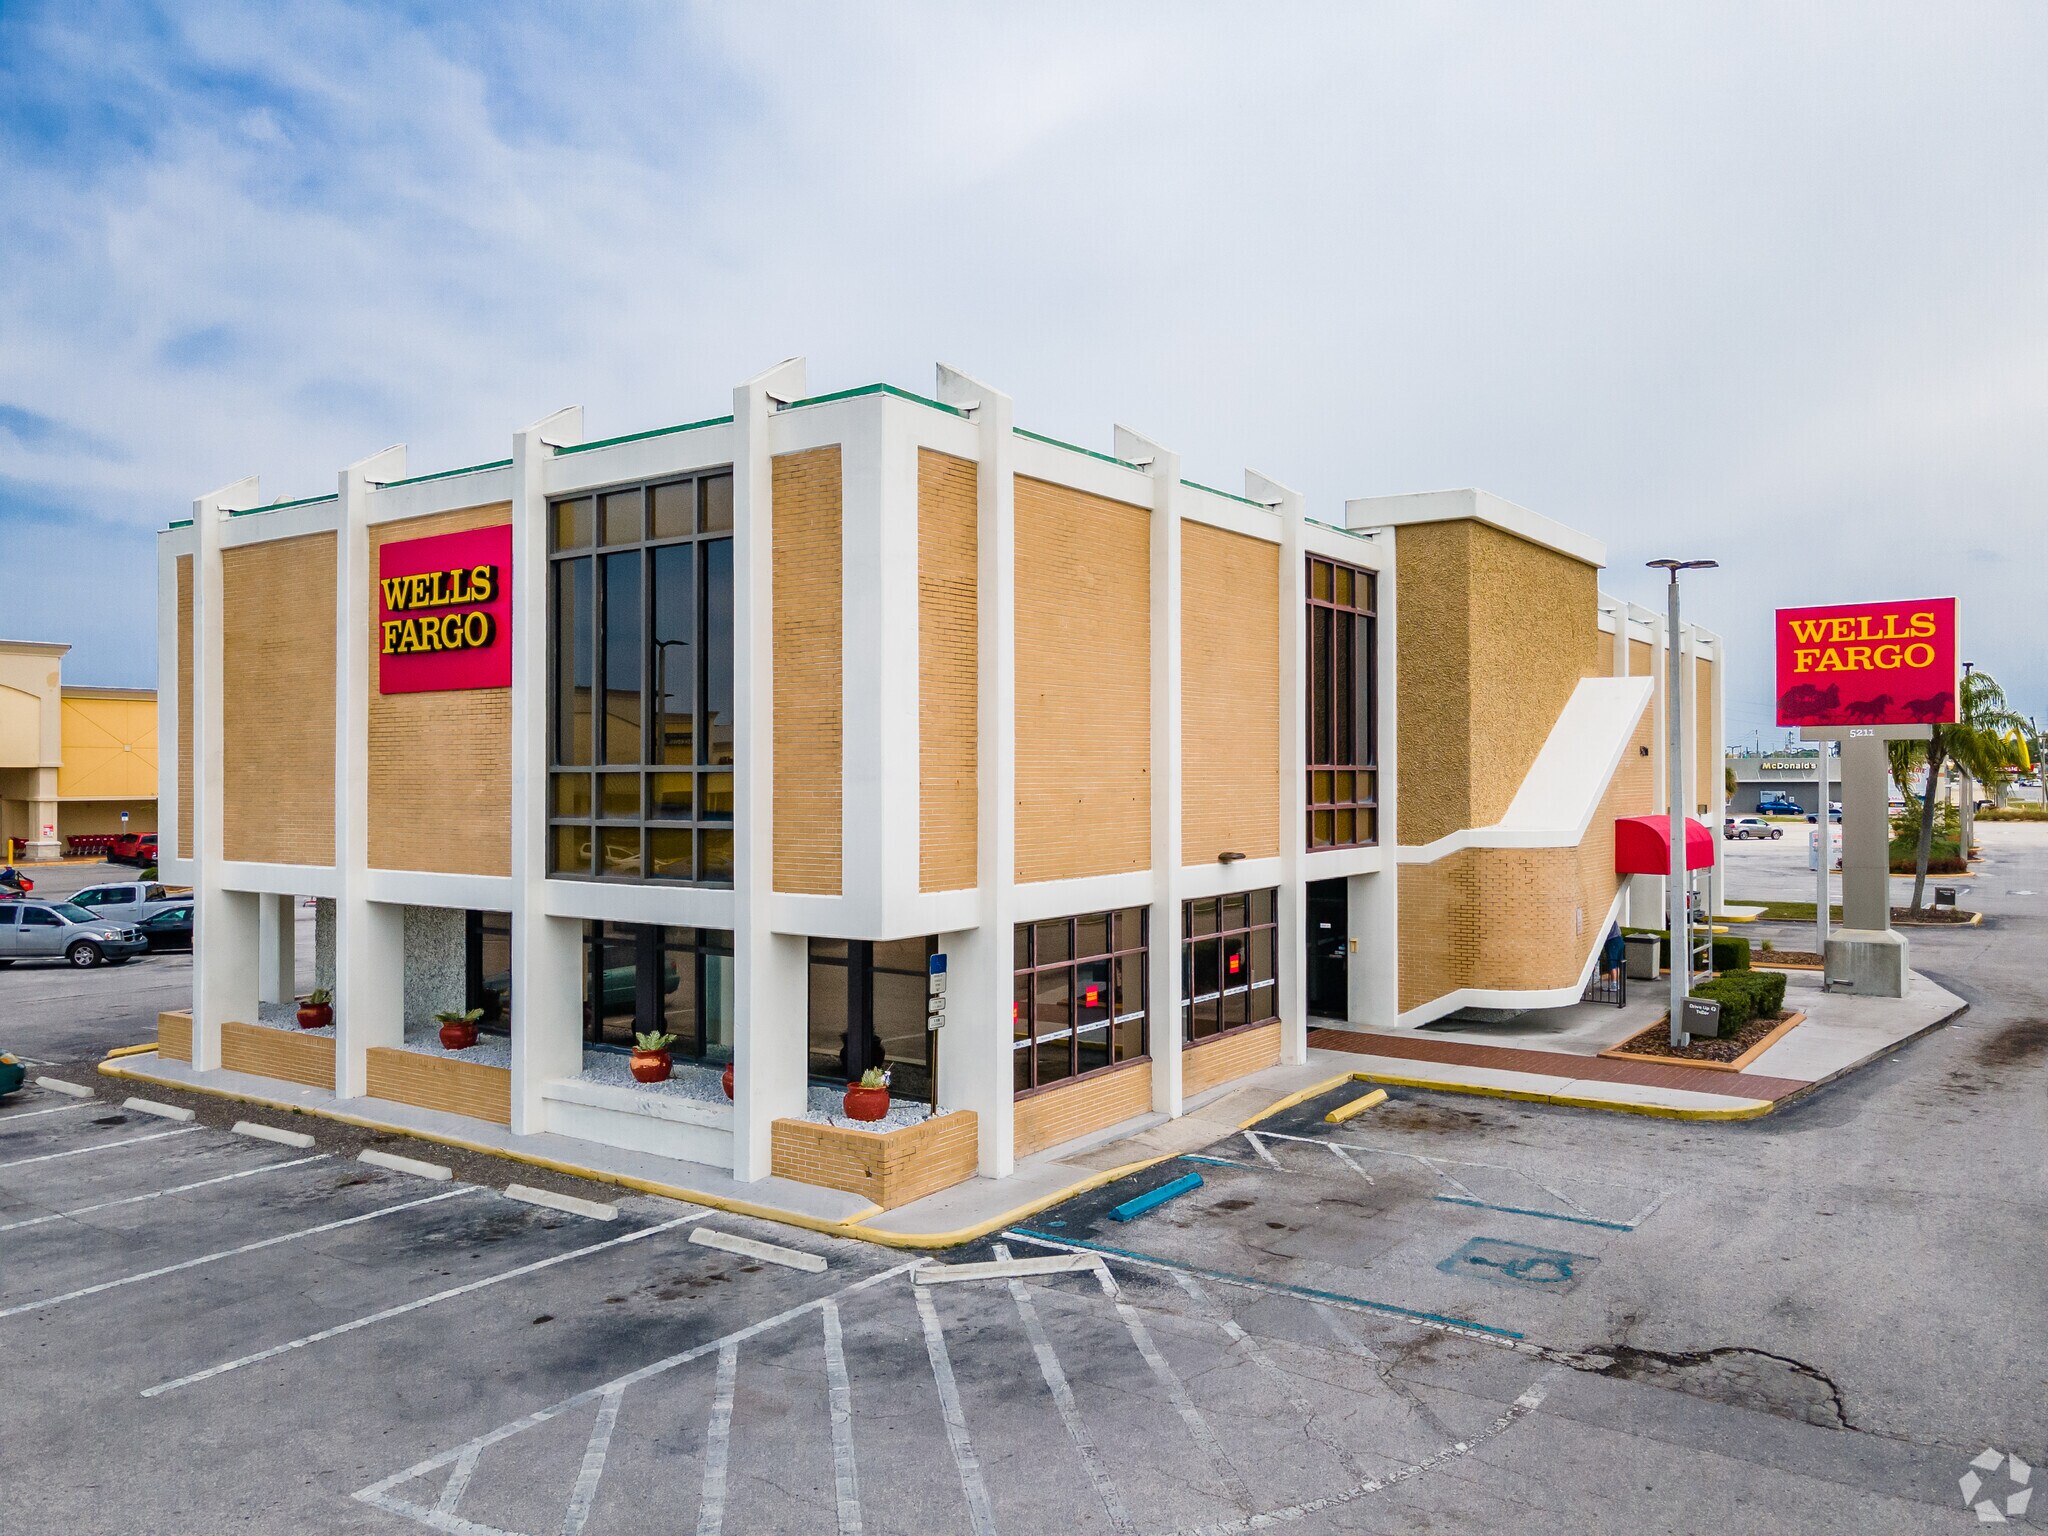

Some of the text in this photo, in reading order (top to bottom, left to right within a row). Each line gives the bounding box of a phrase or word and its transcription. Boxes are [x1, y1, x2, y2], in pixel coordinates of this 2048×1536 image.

[381, 565, 492, 611] WELLS
[382, 611, 490, 654] FARGO
[1789, 612, 1936, 644] WELLS
[1794, 642, 1935, 673] FARGO
[1850, 729, 1875, 738] 5211
[1761, 762, 1817, 770] McDonald's
